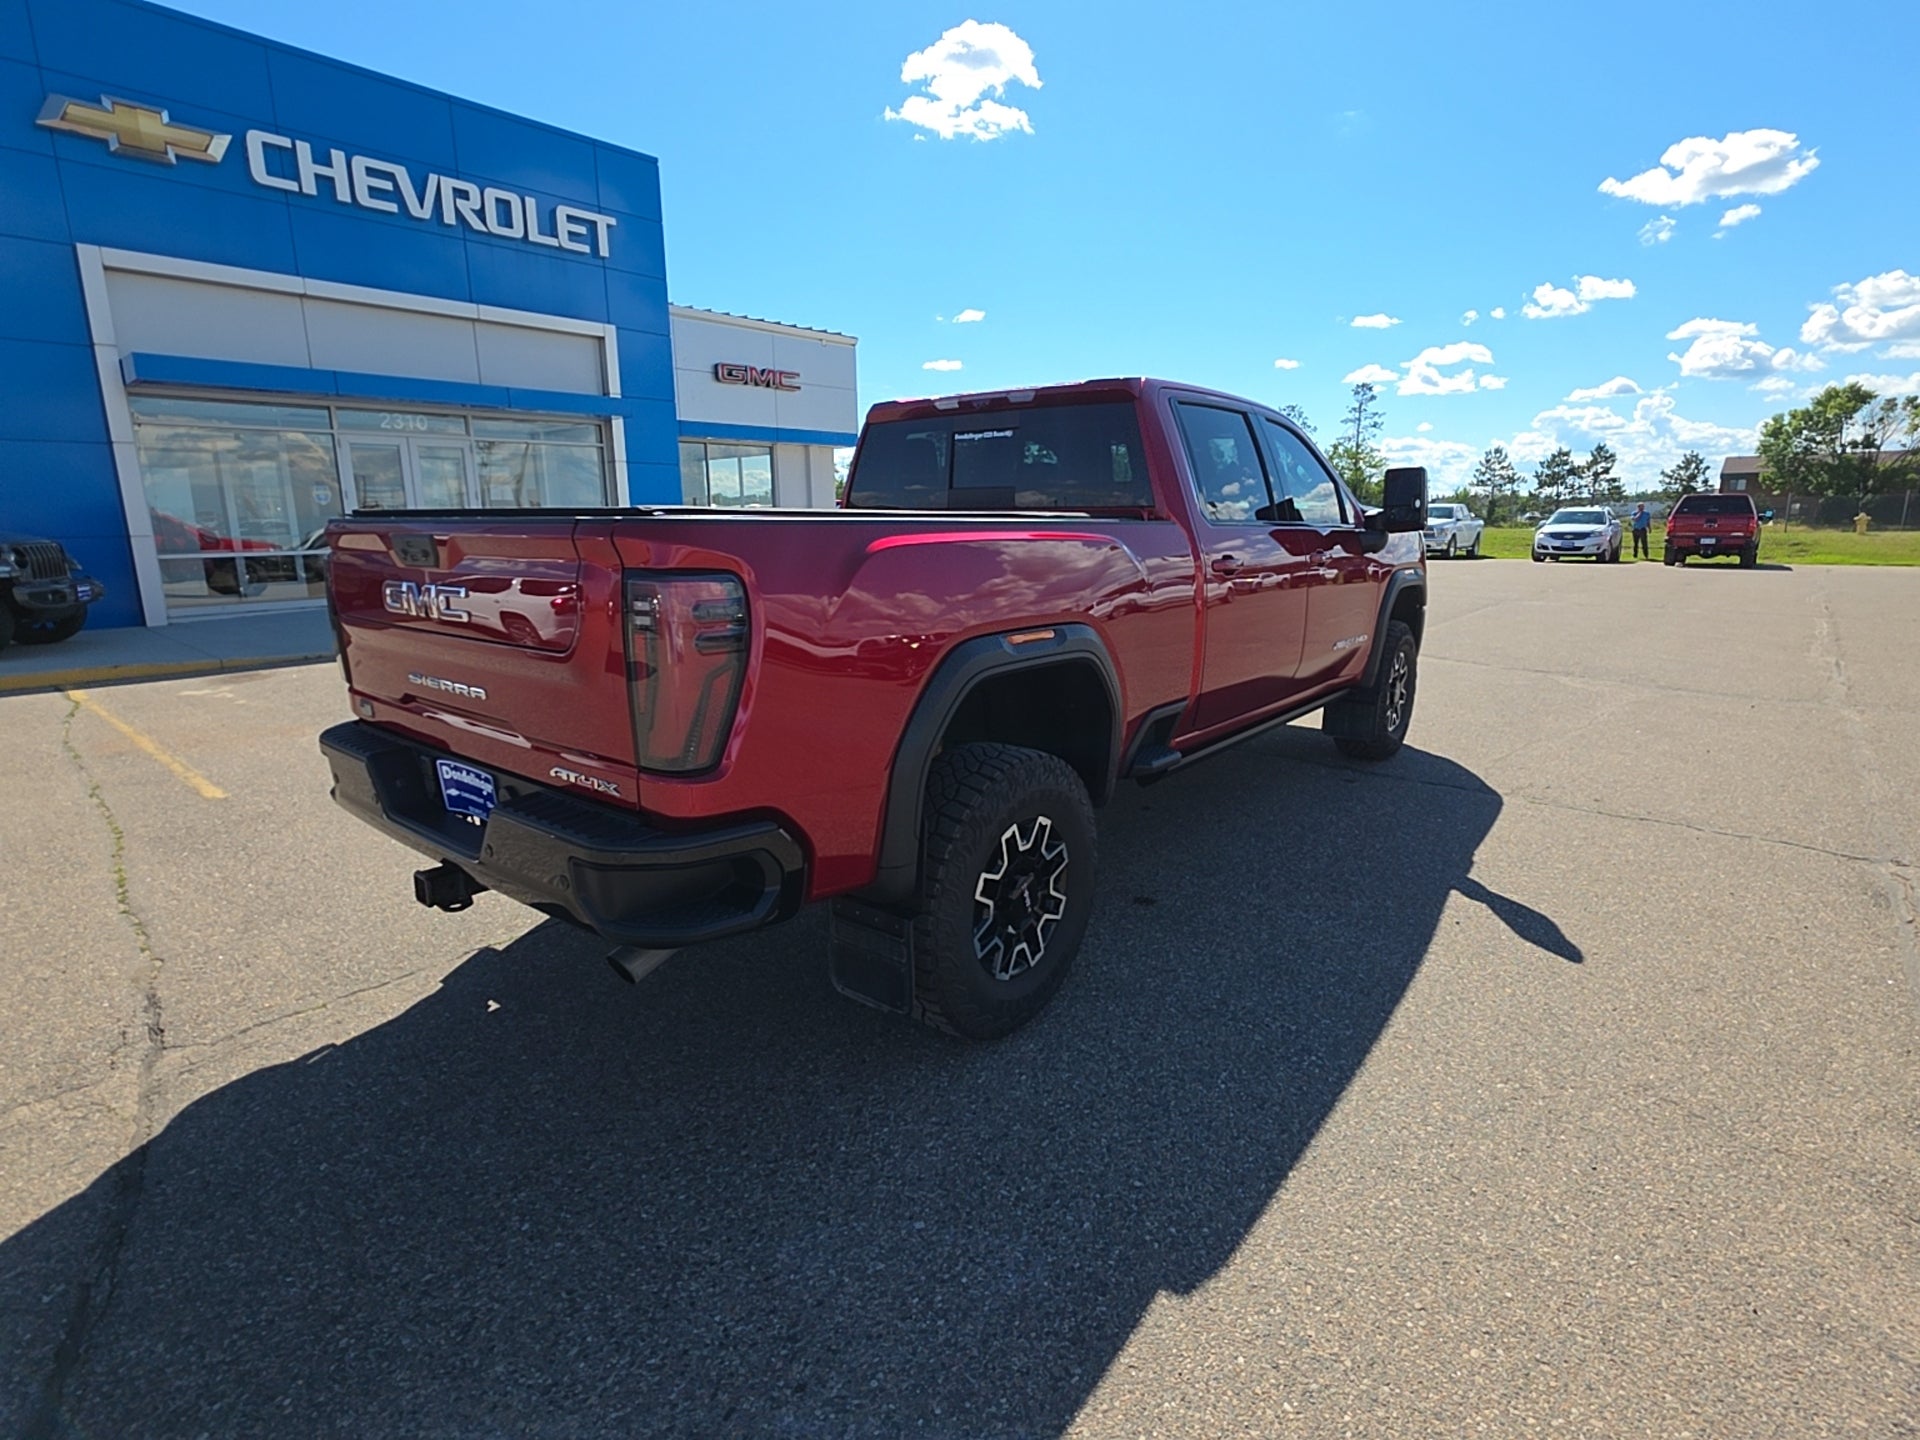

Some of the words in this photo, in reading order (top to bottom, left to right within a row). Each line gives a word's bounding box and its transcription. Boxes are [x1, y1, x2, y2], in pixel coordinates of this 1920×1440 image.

[246, 129, 617, 258] CHEVROLET
[713, 362, 801, 392] GMC
[380, 412, 428, 431] 2310
[382, 580, 470, 622] GMC
[408, 671, 487, 700] SIERRA
[549, 766, 621, 798] AT4X
